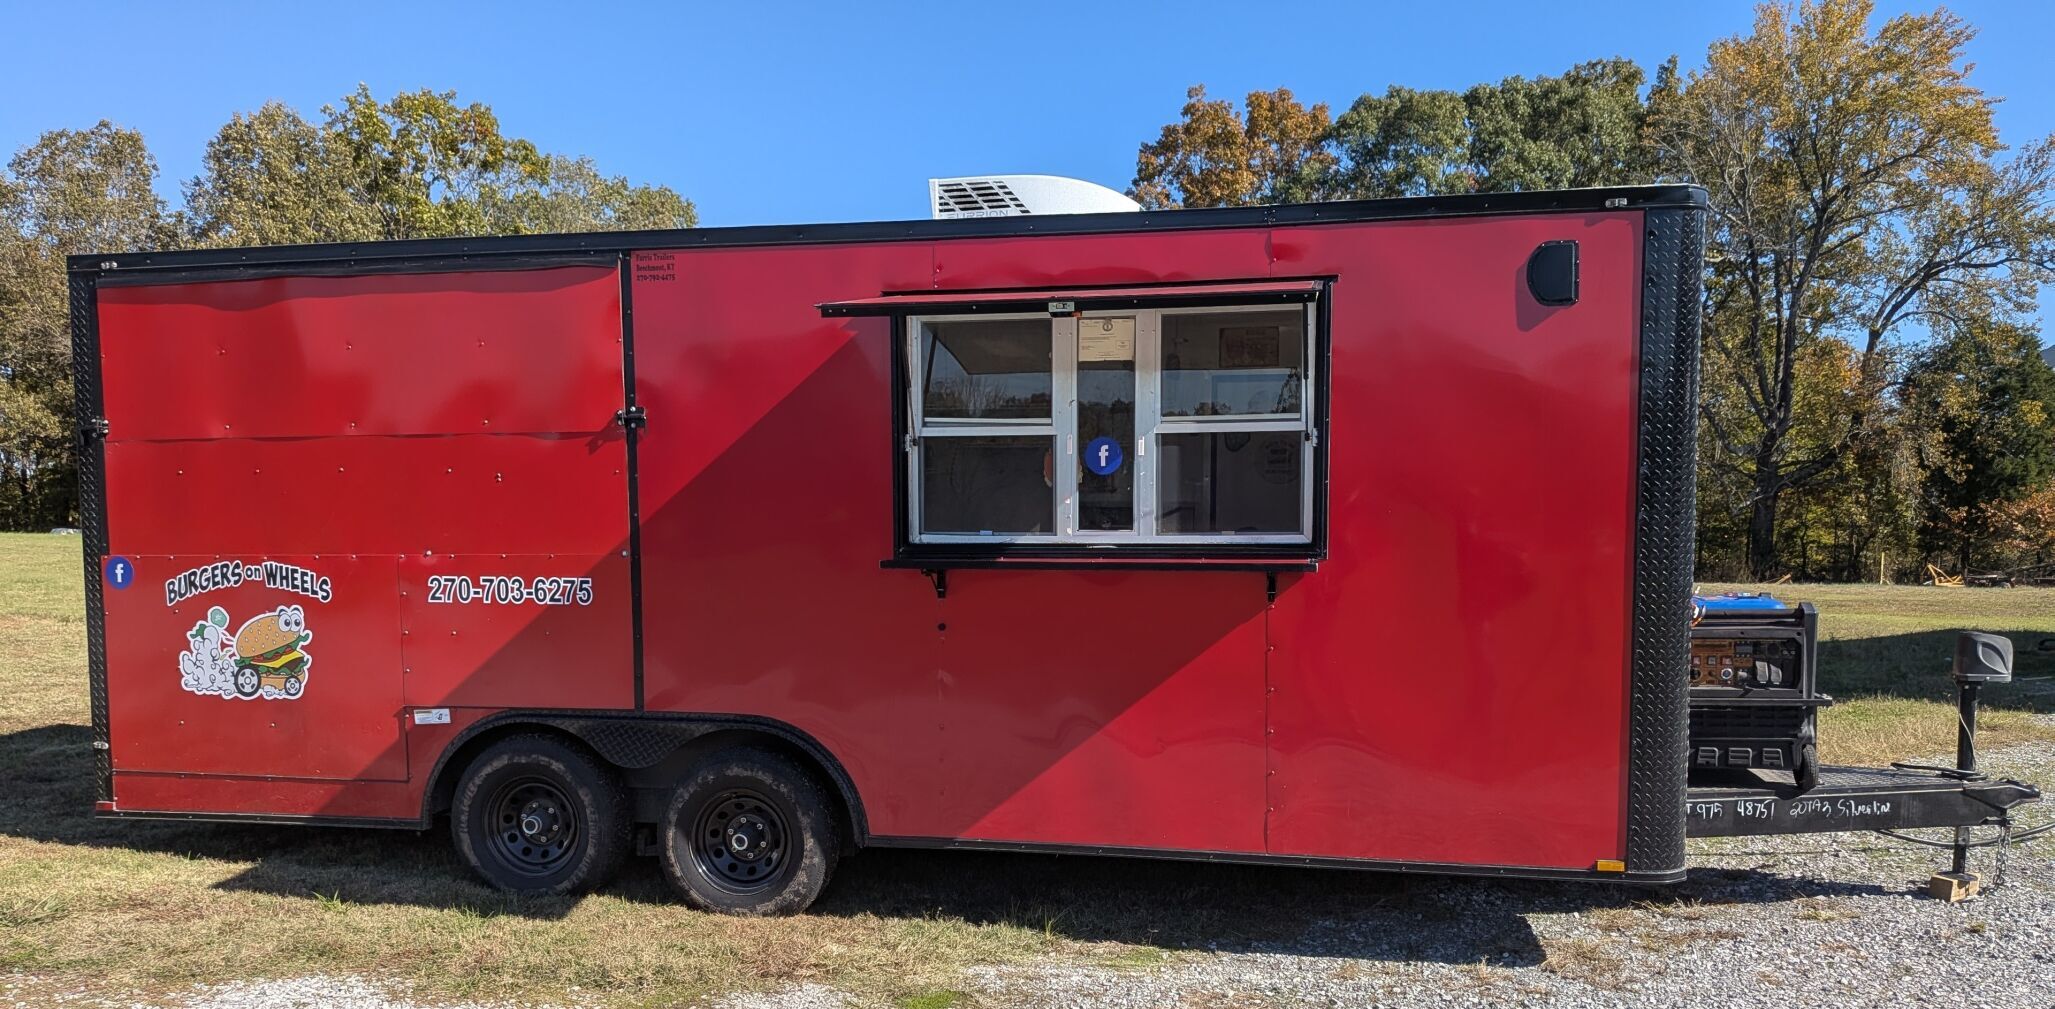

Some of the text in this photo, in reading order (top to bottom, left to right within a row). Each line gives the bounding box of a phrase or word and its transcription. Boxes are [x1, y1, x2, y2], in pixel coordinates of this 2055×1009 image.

[165, 560, 332, 605] BURGERS on WHEELS
[428, 575, 593, 606] 270-703-6275
[1737, 799, 1775, 820] 48751
